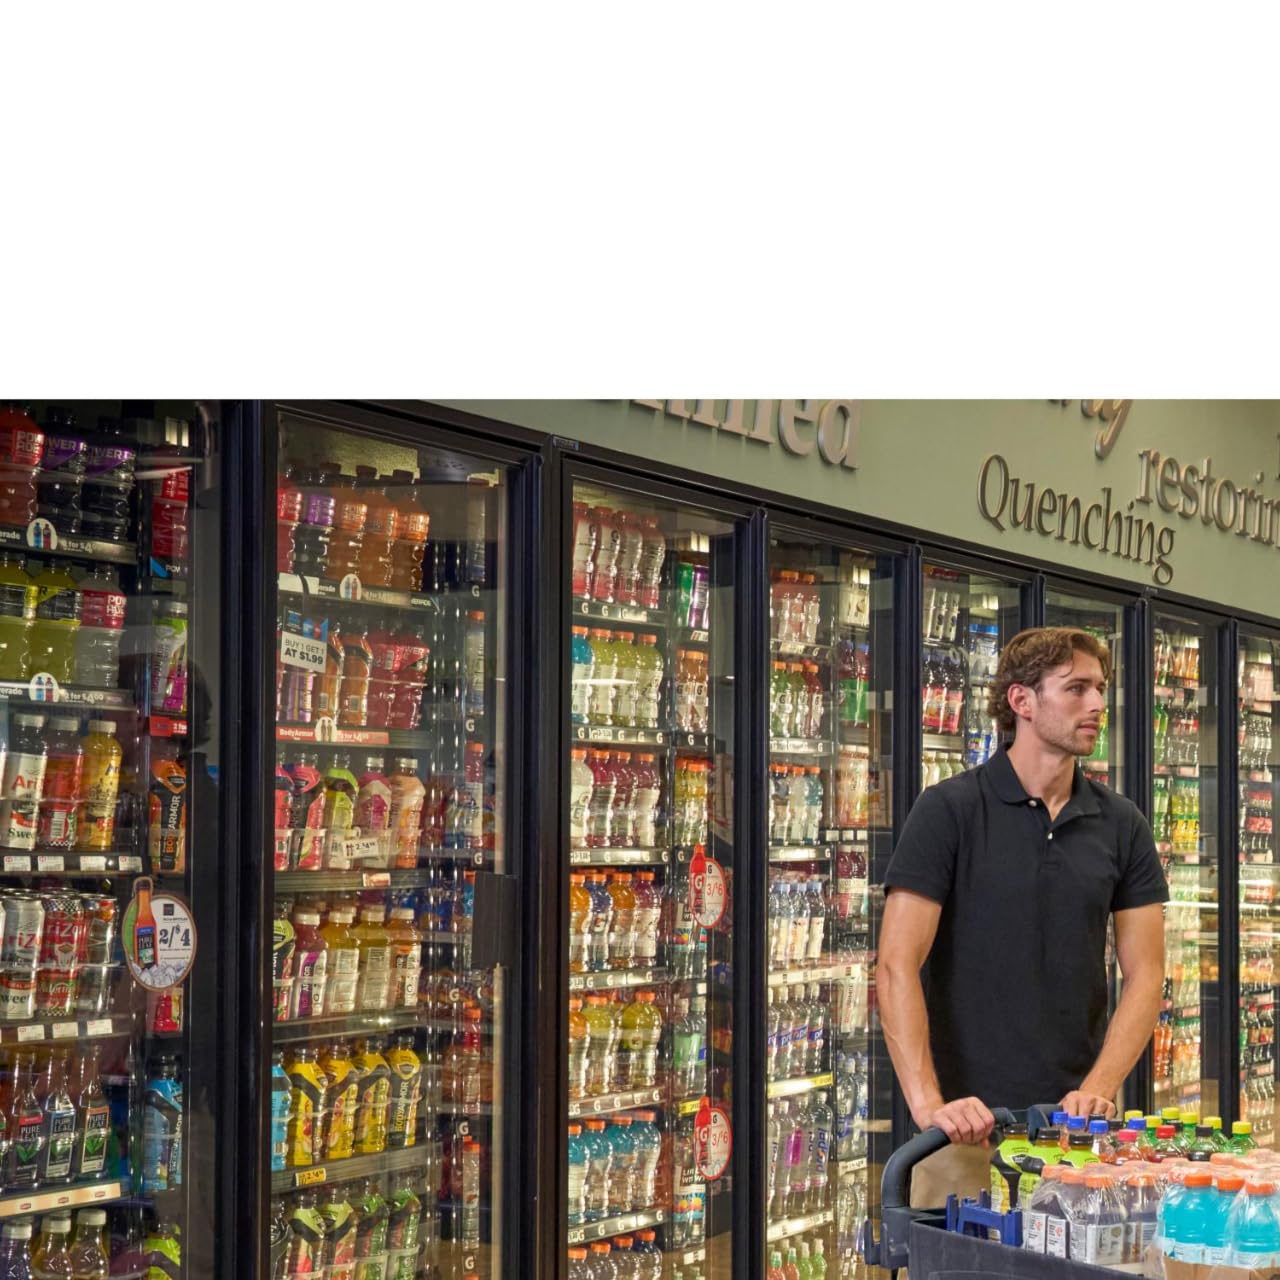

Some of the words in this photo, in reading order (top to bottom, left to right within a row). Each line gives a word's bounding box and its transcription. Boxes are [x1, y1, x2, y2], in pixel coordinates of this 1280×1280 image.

[977, 454, 1176, 584] Quenching
[472, 586, 479, 597] G
[285, 639, 299, 648] BUY
[305, 643, 320, 652] GET
[285, 648, 297, 657] AT
[300, 651, 324, 665] $1.99
[466, 720, 475, 731] G
[656, 732, 663, 743] G
[688, 734, 694, 745] G
[474, 852, 483, 864] G
[662, 851, 669, 862] G
[678, 851, 684, 861] G
[587, 977, 593, 988] G
[594, 1100, 600, 1111] G
[614, 1097, 621, 1108] G
[653, 1090, 659, 1101] G
[21, 1126, 40, 1134] PURE
[459, 1122, 469, 1135] G
[656, 1210, 663, 1221] G
[598, 1225, 605, 1236] G
[464, 1256, 474, 1270] G
